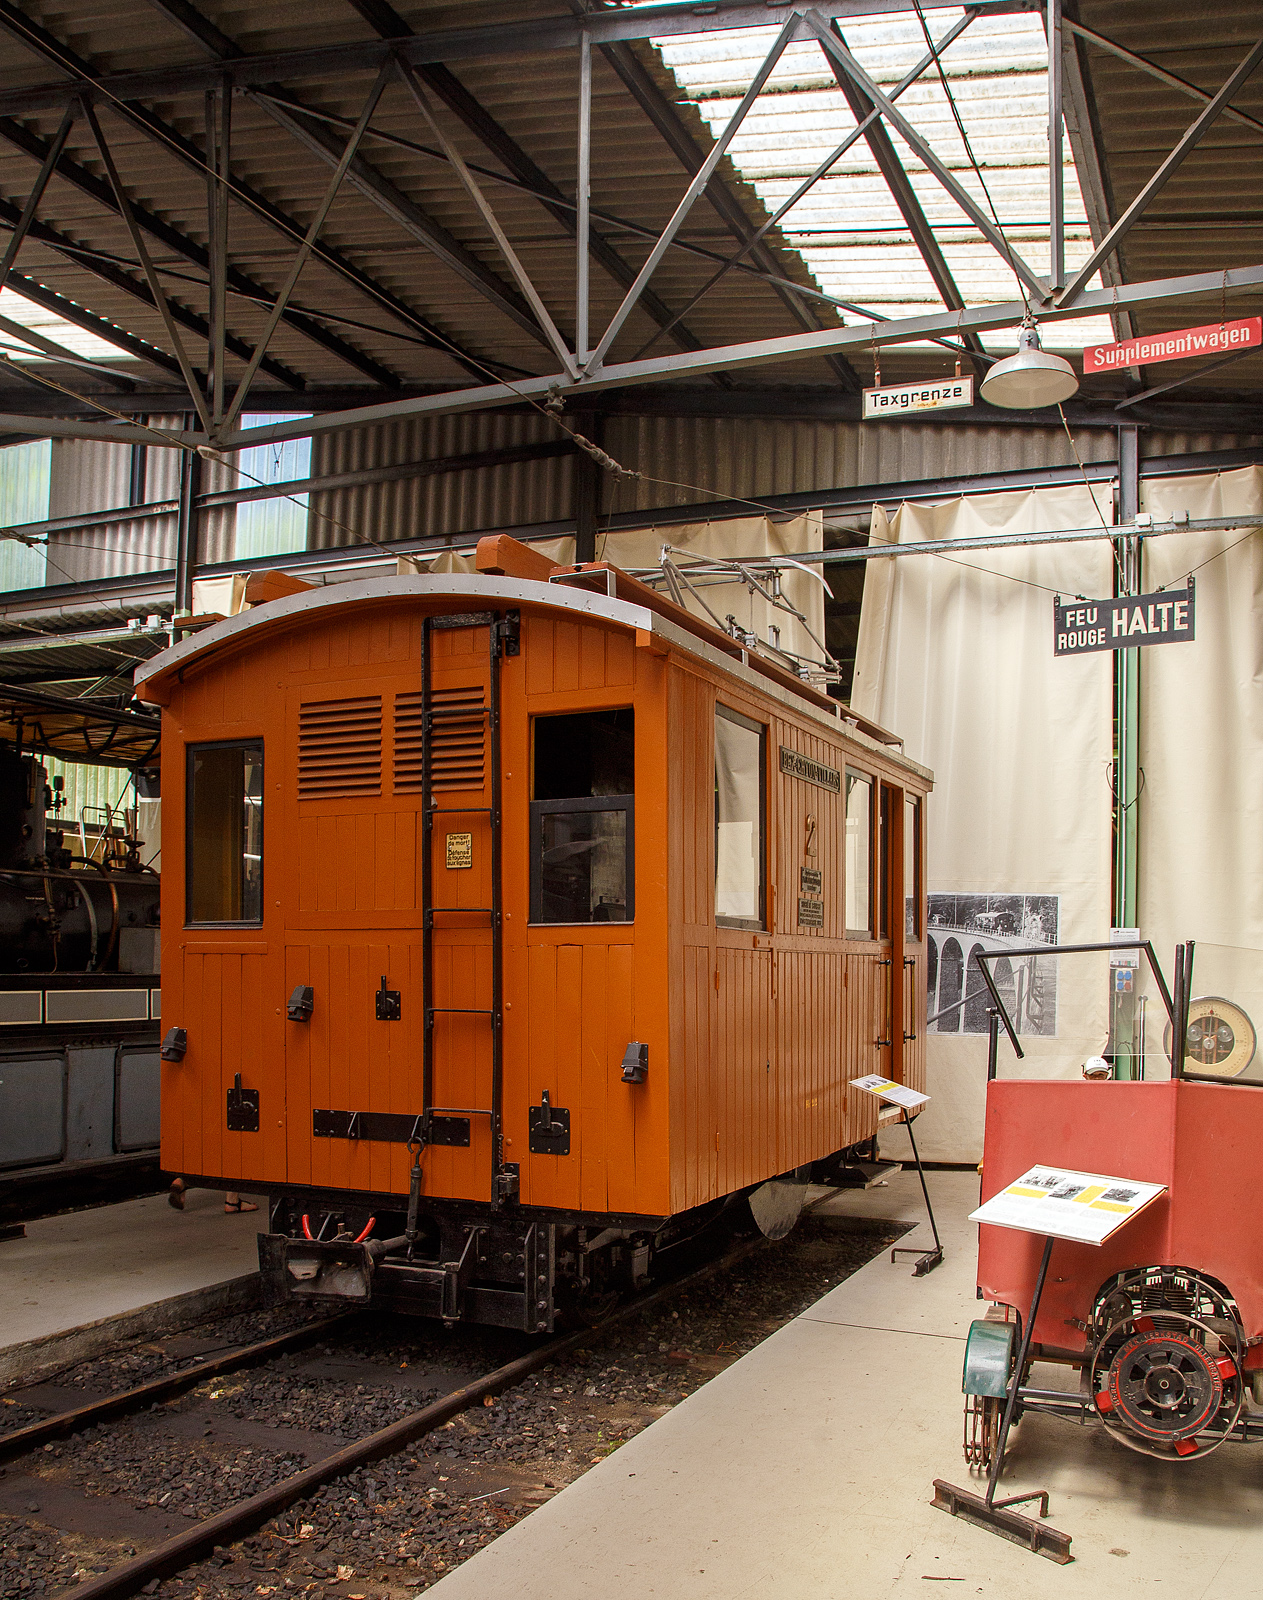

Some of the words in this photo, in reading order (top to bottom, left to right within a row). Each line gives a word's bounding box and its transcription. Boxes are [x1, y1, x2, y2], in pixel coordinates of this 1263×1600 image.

[1093, 326, 1251, 367] Supplementwagen
[870, 385, 962, 408] Taxgrenze
[1066, 607, 1098, 628] FEU
[1112, 600, 1189, 638] HALTE
[1058, 627, 1106, 650] ROUGE
[806, 814, 817, 857] 2
